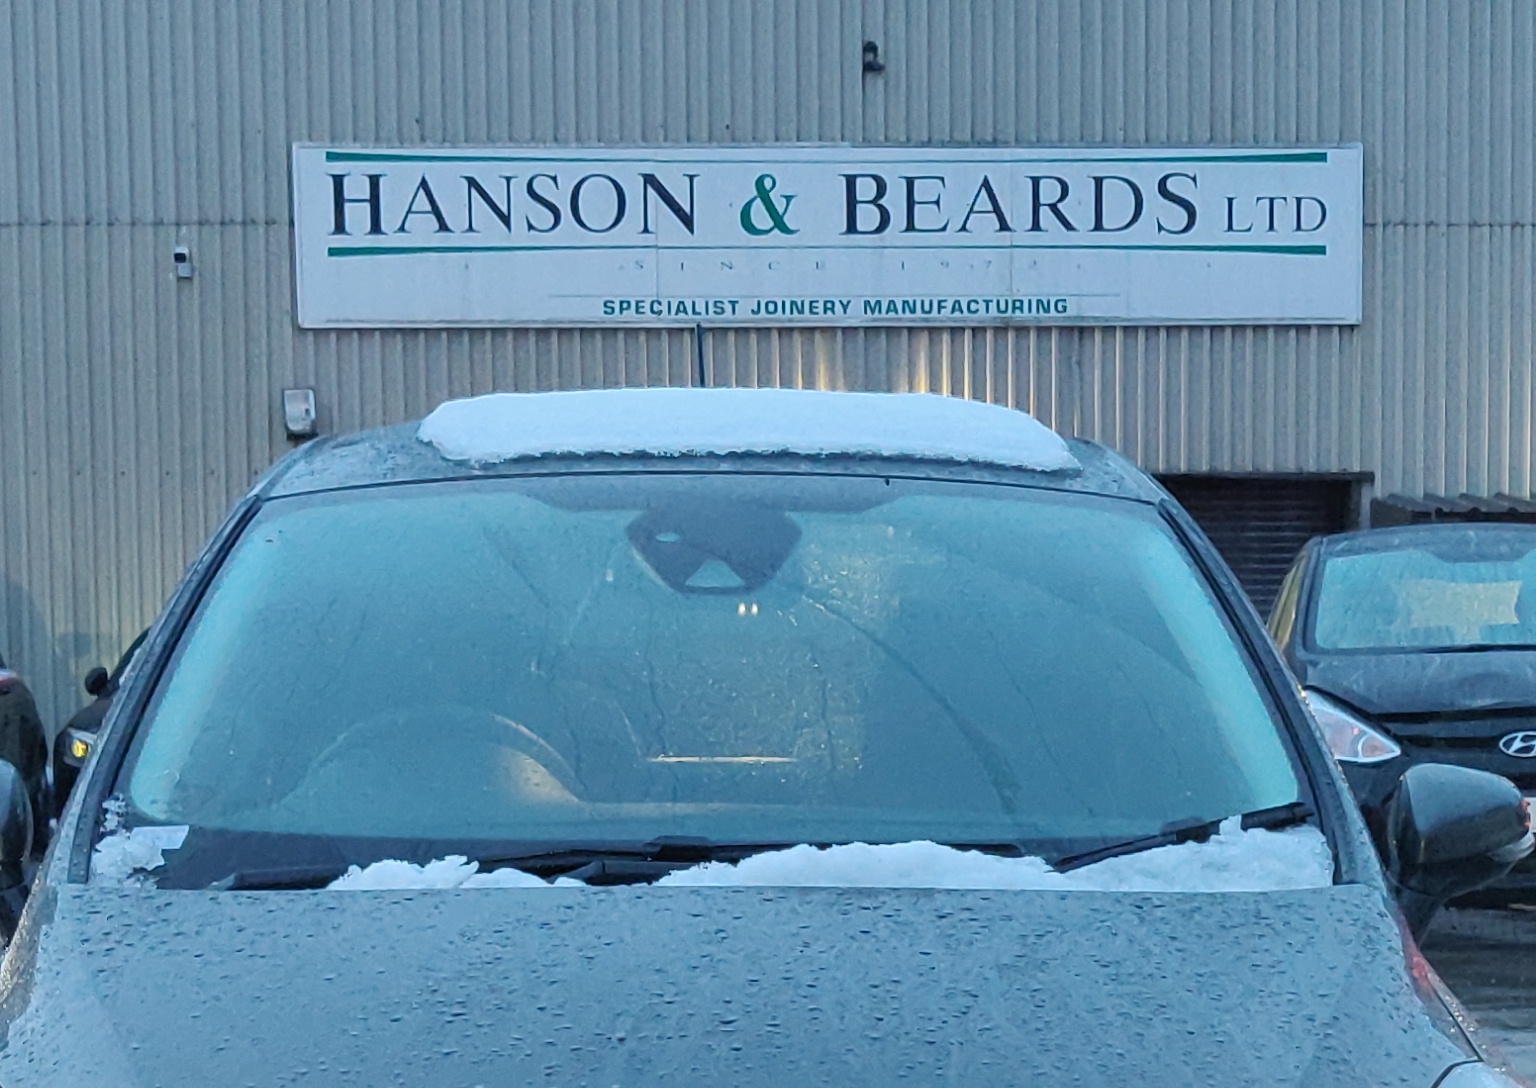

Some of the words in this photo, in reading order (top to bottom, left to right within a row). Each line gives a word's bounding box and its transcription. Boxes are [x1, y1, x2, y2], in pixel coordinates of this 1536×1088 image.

[325, 172, 701, 236] HANSON
[739, 173, 800, 236] &
[837, 172, 1199, 236] BEARDS
[1223, 196, 1328, 234] LTD
[602, 299, 740, 317] SPECIALIST
[750, 299, 852, 316] JOINERY
[863, 298, 1069, 316] MANUFACTURING
